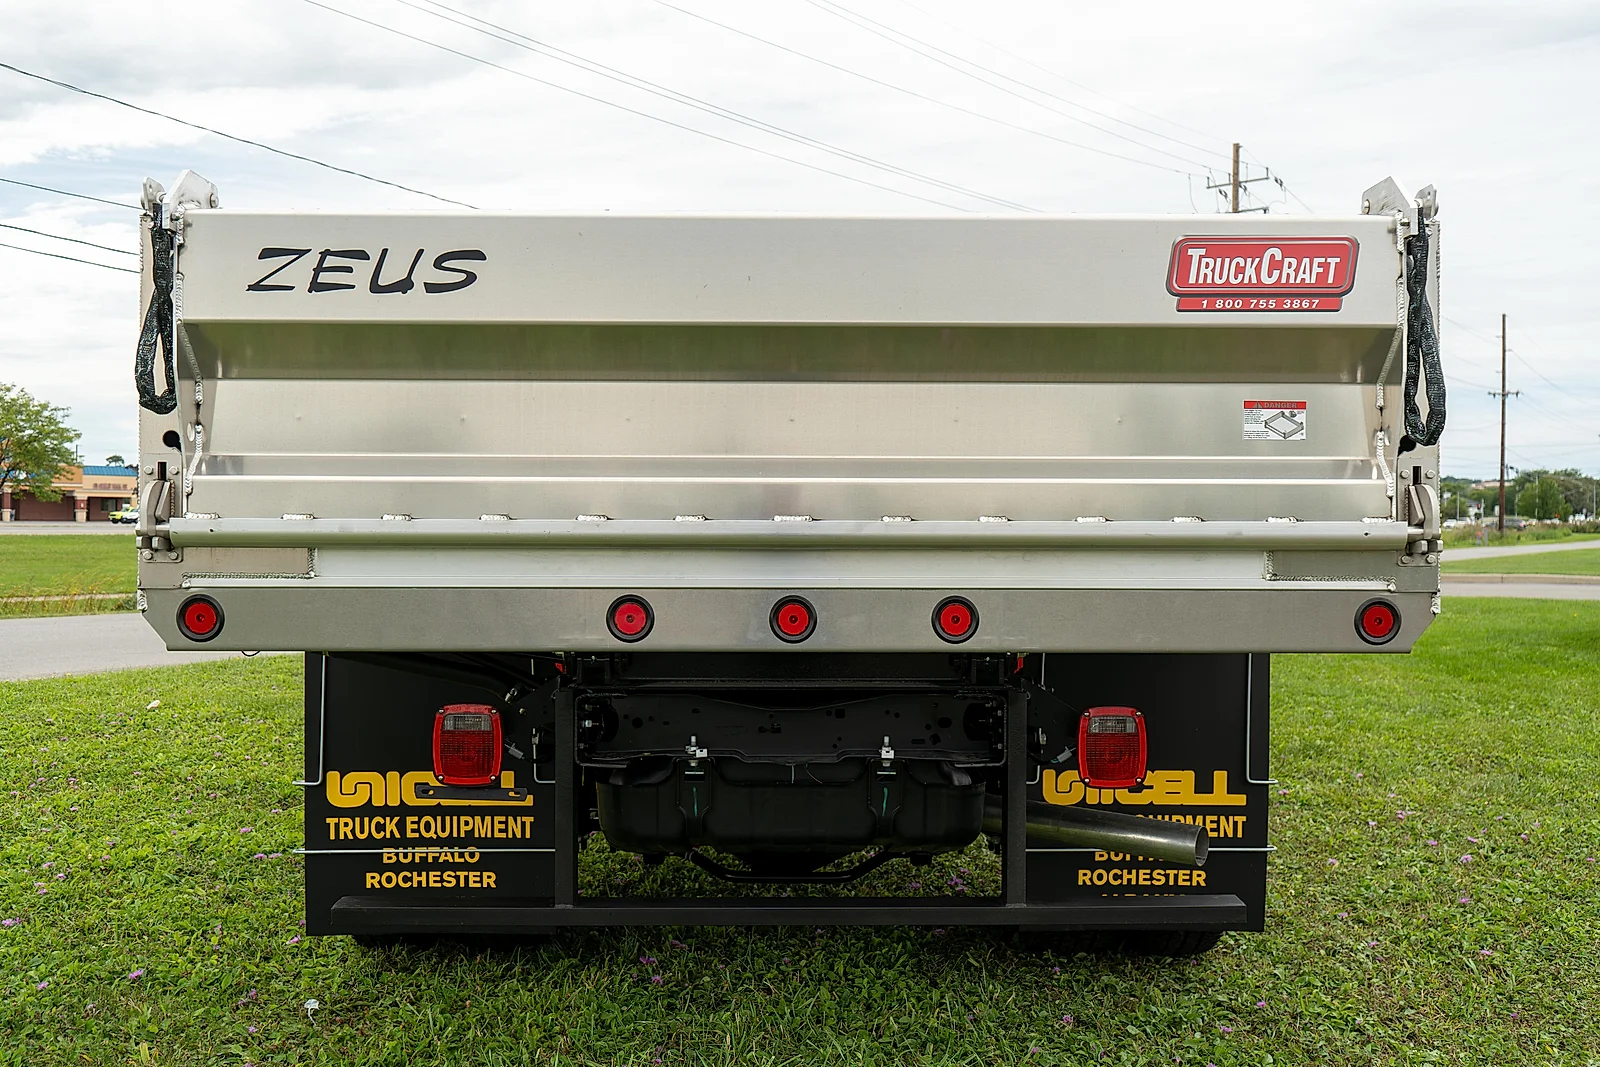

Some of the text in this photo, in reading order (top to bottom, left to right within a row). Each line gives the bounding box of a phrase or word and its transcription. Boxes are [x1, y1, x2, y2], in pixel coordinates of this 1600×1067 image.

[245, 247, 487, 294] ZEUS
[1201, 299, 1320, 309] 1 800 755 3867
[326, 816, 534, 840] TRUCK EQUIPMENT
[382, 846, 480, 864] BUFFALO
[365, 871, 497, 889] ROCHESTER
[1077, 869, 1207, 887] ROCHESTER
